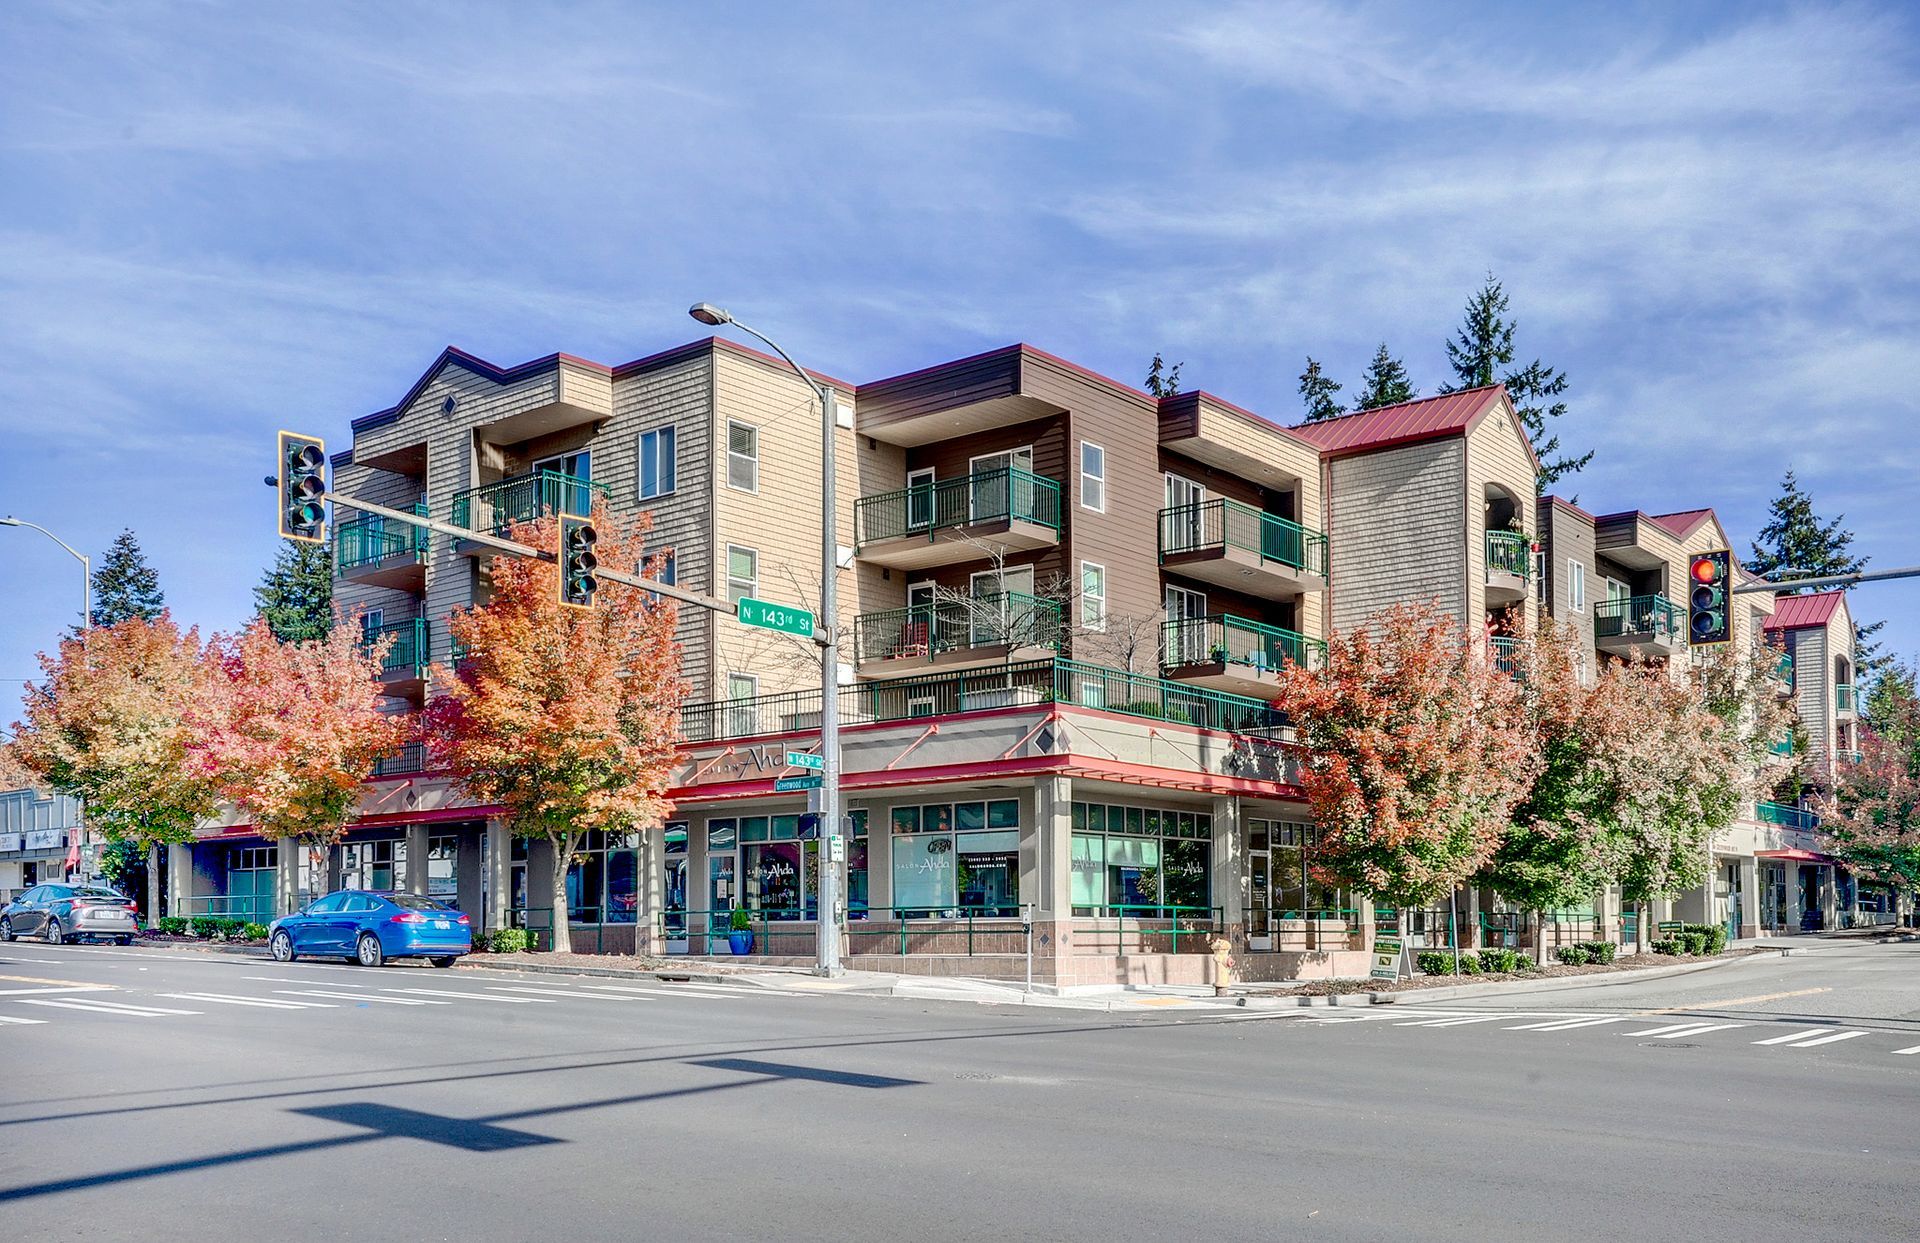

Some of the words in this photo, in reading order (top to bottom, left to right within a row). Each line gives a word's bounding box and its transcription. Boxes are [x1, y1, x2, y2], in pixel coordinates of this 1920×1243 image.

[743, 606, 751, 619] N
[761, 608, 793, 627] 143rd
[799, 617, 810, 631] St
[739, 742, 787, 779] Ahd
[776, 779, 801, 791] Greenwood
[927, 839, 952, 854] OPEN
[766, 862, 794, 880] Ahda
[896, 861, 919, 870] SALON
[918, 855, 950, 875] Ahda
[1182, 861, 1203, 877] Ahda
